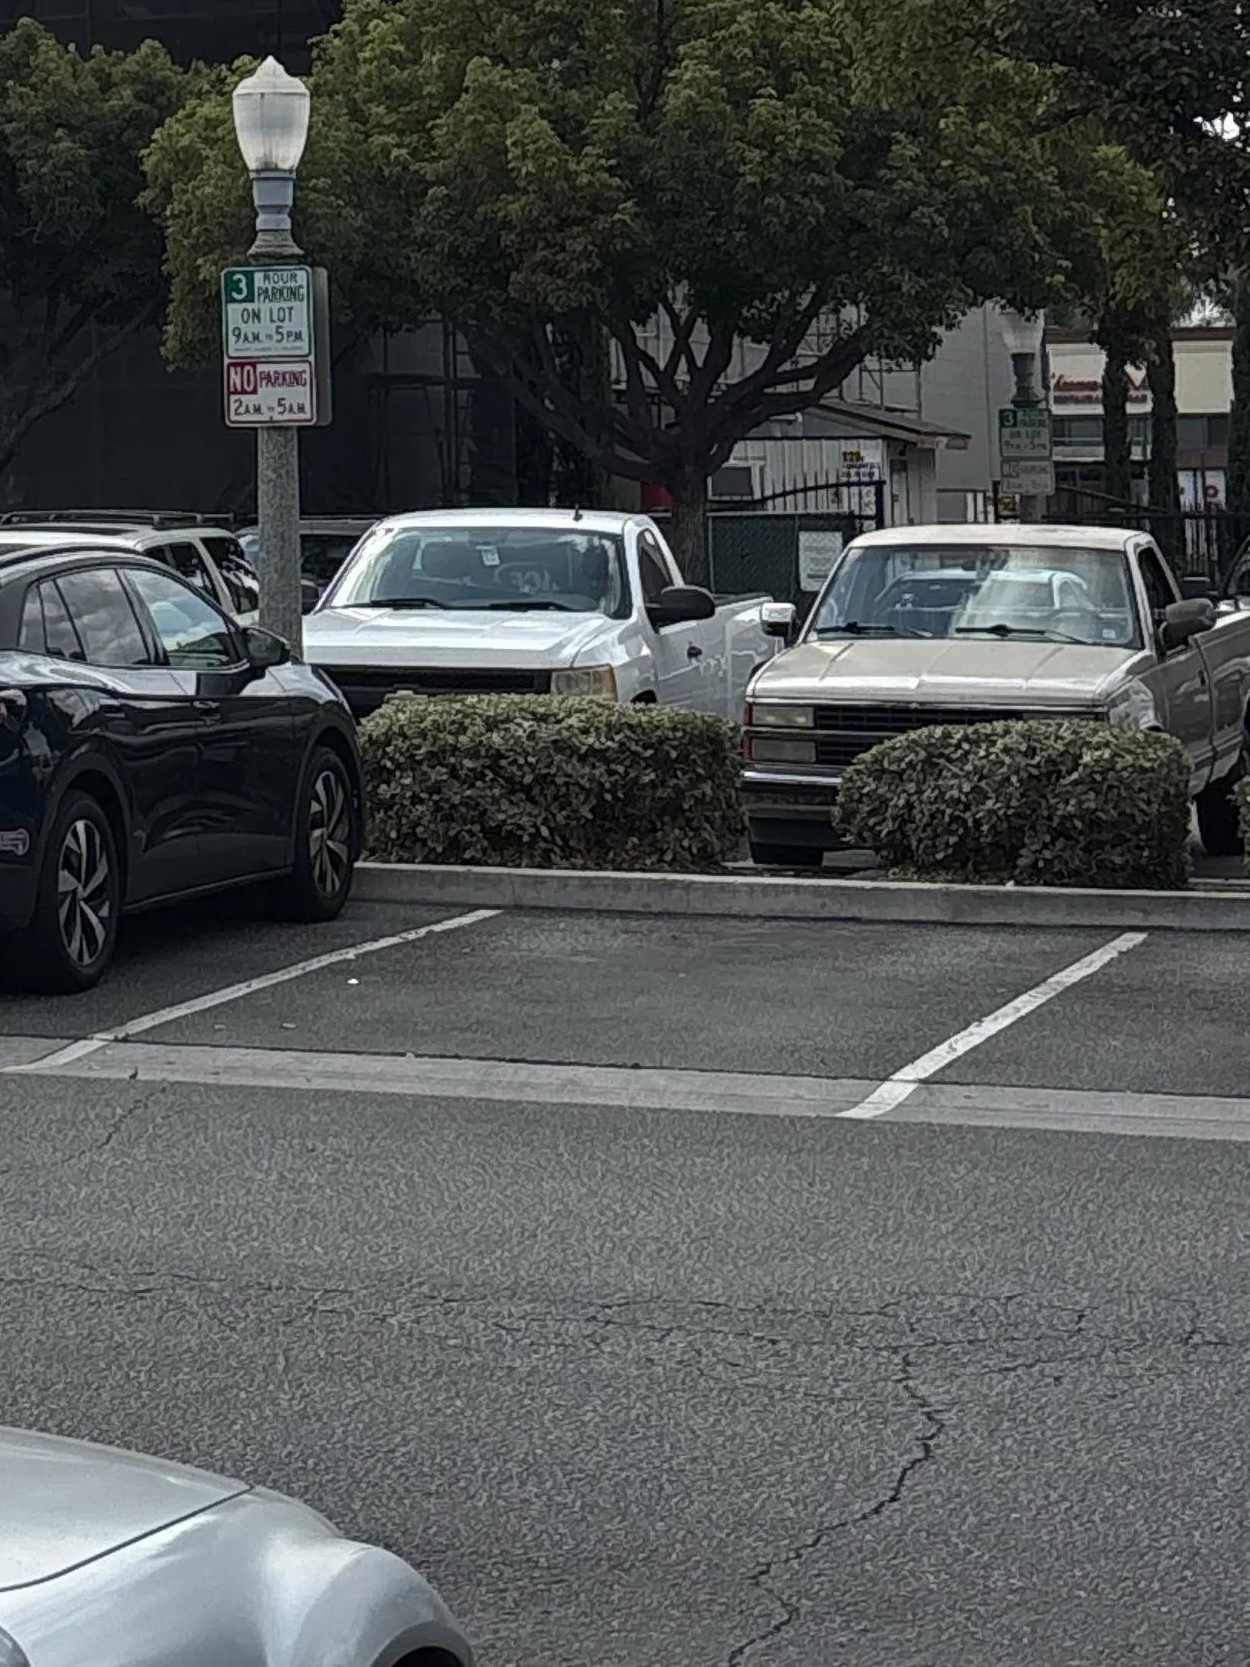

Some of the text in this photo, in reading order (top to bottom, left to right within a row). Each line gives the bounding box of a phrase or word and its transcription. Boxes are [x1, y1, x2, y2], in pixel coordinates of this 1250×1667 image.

[231, 274, 248, 300] 3
[263, 271, 298, 285] HOUR
[257, 284, 305, 304] PARKING
[241, 306, 294, 324] ON LOT
[230, 365, 307, 392] NO PARKING
